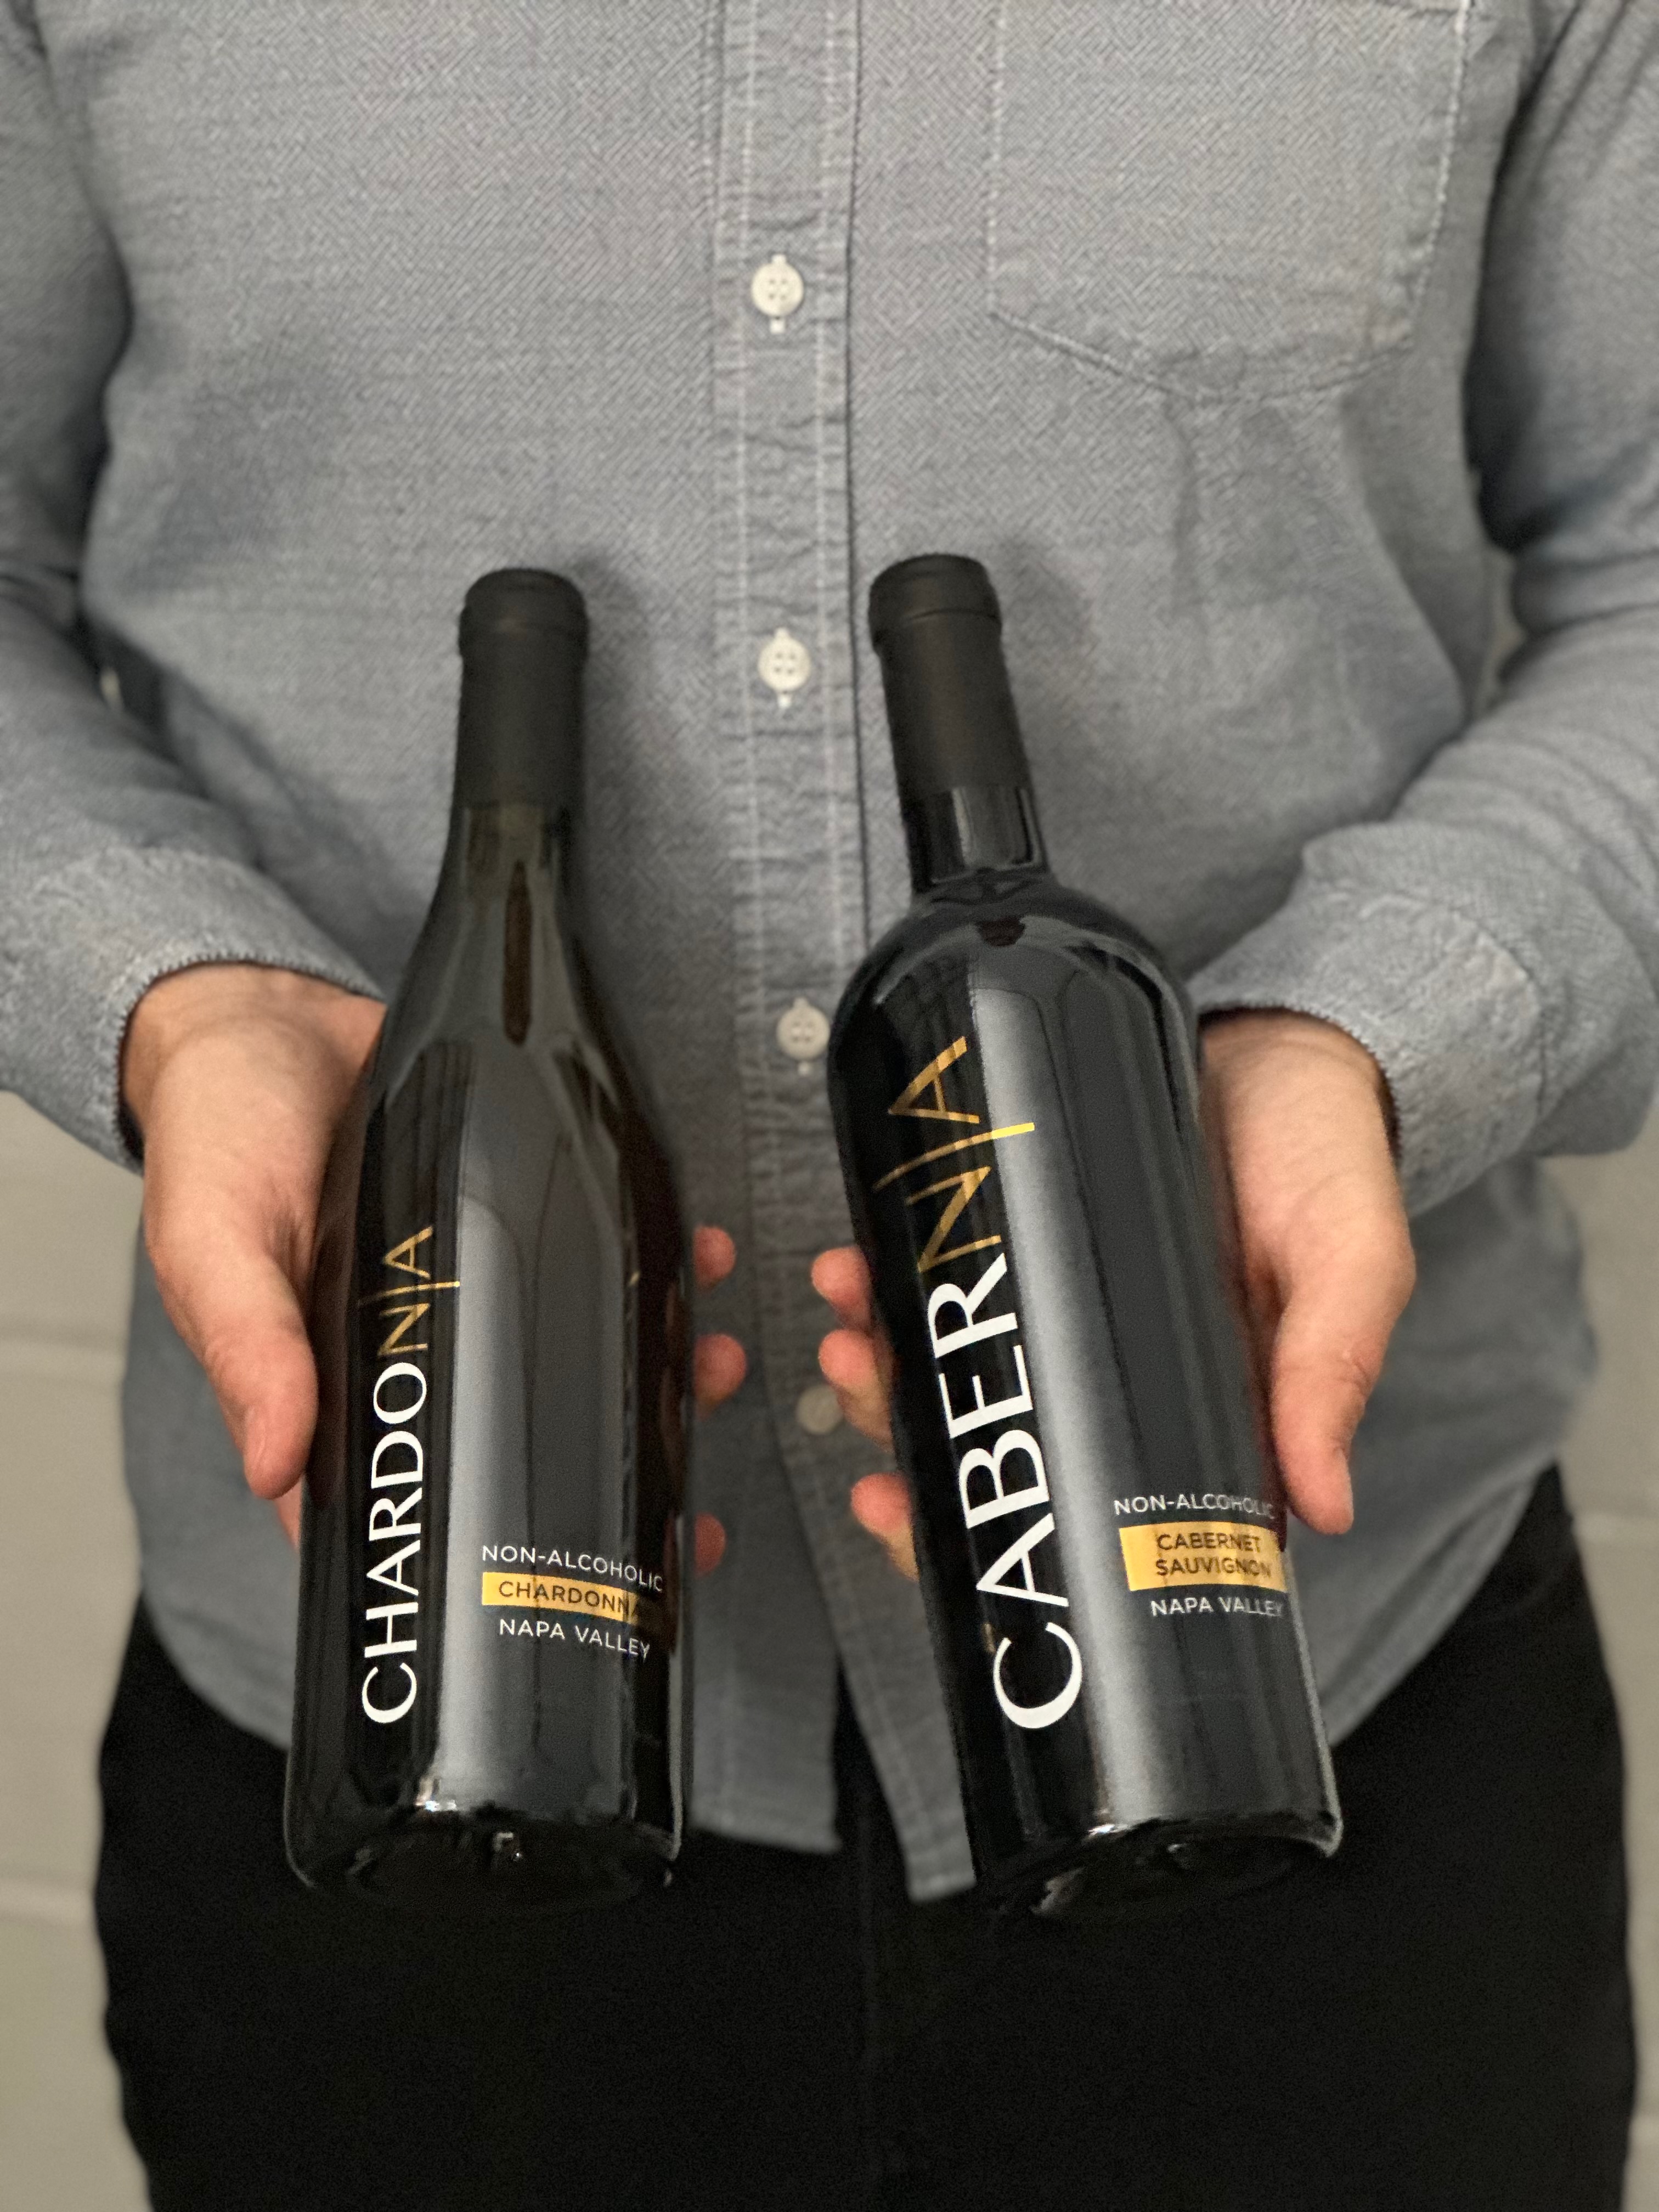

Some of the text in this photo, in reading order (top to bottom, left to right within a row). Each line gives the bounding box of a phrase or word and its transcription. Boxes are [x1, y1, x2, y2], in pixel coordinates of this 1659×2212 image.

[1114, 1493, 1276, 1519] NON-ALCOHOLIC
[1156, 1532, 1261, 1553] CABERNET
[482, 1545, 663, 1593] NON-ALCOHOLIC
[1155, 1557, 1272, 1578] SAUVIGNON
[1150, 1597, 1285, 1618] NAPA VALLEY
[499, 1619, 651, 1663] NAPA VALLEY
